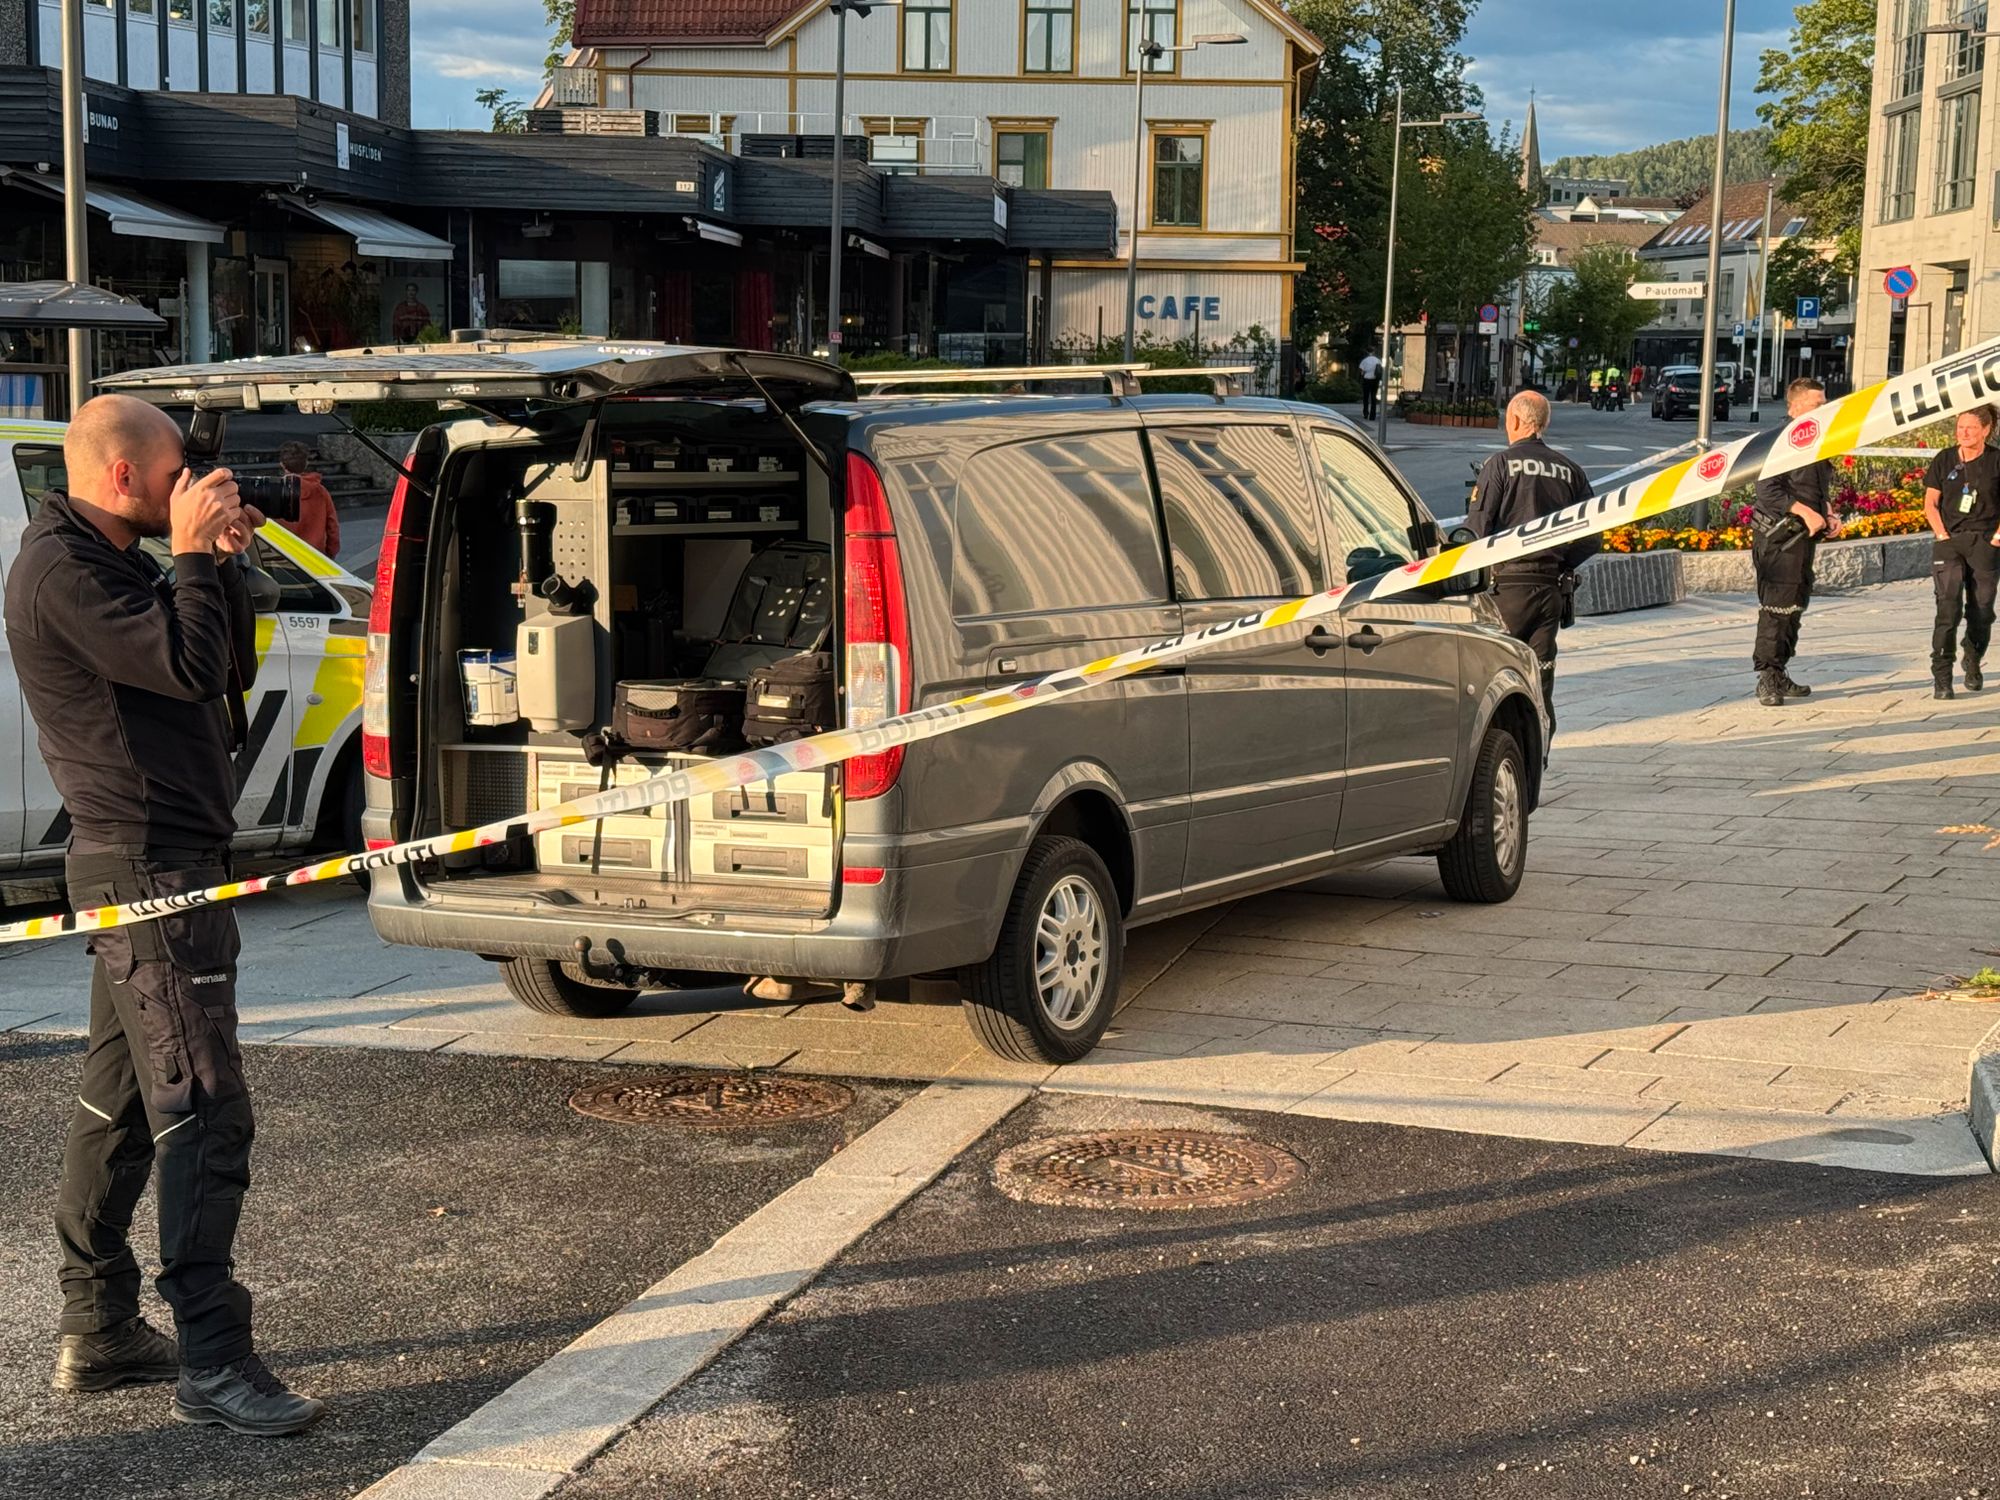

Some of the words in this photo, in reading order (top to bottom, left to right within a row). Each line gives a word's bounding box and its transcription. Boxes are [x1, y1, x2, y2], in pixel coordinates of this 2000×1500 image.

[89, 111, 119, 131] BUNAD
[1136, 295, 1220, 321] CAFE
[1802, 300, 1814, 316] P
[1792, 424, 1817, 444] STOP
[1508, 458, 1572, 484] POLITI
[1700, 456, 1725, 473] STOP
[289, 616, 320, 629] 5597
[191, 973, 227, 985] wenaas
